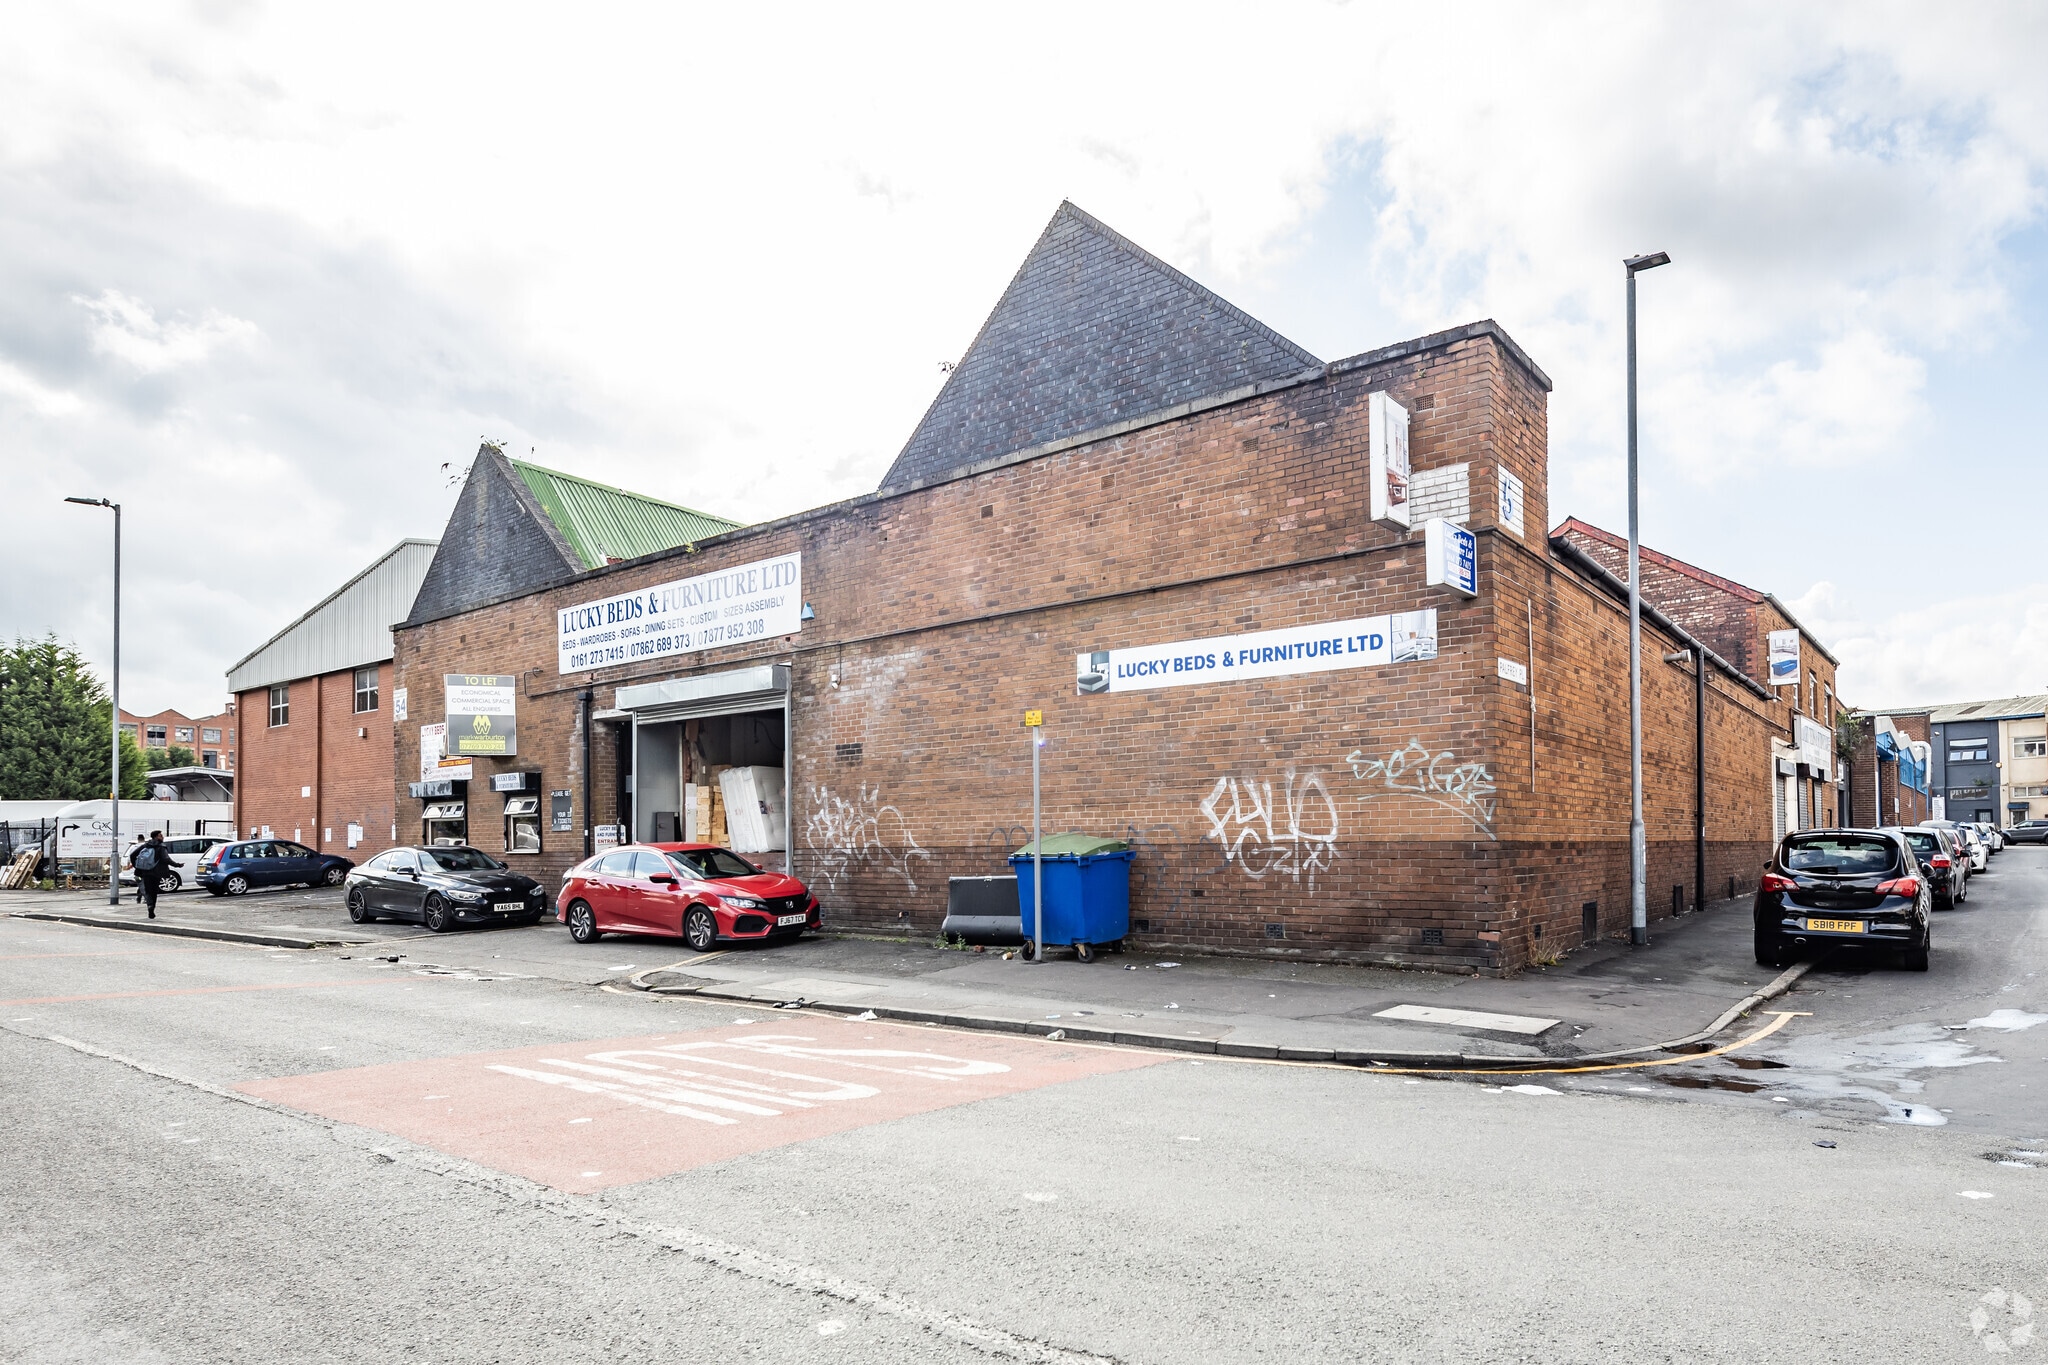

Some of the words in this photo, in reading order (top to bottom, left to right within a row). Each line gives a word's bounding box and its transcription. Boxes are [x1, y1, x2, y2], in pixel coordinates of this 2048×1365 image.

[1468, 539, 1473, 549] &
[563, 604, 605, 634] LUCKY
[607, 596, 643, 624] BEDS
[648, 592, 659, 615] &
[662, 569, 758, 613] FURNITURE
[762, 561, 797, 590] LTD
[562, 640, 576, 650] BEDS
[580, 631, 616, 646] WARDROBES
[620, 626, 640, 638] SOFAS
[645, 621, 666, 634] DINING
[667, 618, 685, 629] SETS
[690, 610, 718, 625] CUSTOM
[724, 604, 744, 617] SIZES
[745, 596, 785, 613] ASSEMBLY
[571, 653, 587, 667] 0161
[590, 650, 604, 664] 273
[605, 646, 624, 661] 7415
[630, 640, 654, 657] 07862
[656, 636, 672, 652] 689
[674, 633, 690, 649] 373
[698, 626, 724, 645] 07877
[727, 622, 744, 639] 952
[747, 618, 764, 635] 308
[1118, 659, 1170, 678] LUCKY
[1173, 653, 1216, 673] BEDS
[1222, 651, 1234, 667] &
[1239, 638, 1343, 665] FURNITURE
[1348, 633, 1384, 653] LTD
[464, 676, 479, 685] TO
[482, 676, 498, 686] LET
[395, 698, 406, 713] 54
[780, 916, 794, 925] FJ67
[1813, 920, 1835, 929] SB18
[1837, 921, 1857, 930] FPF
